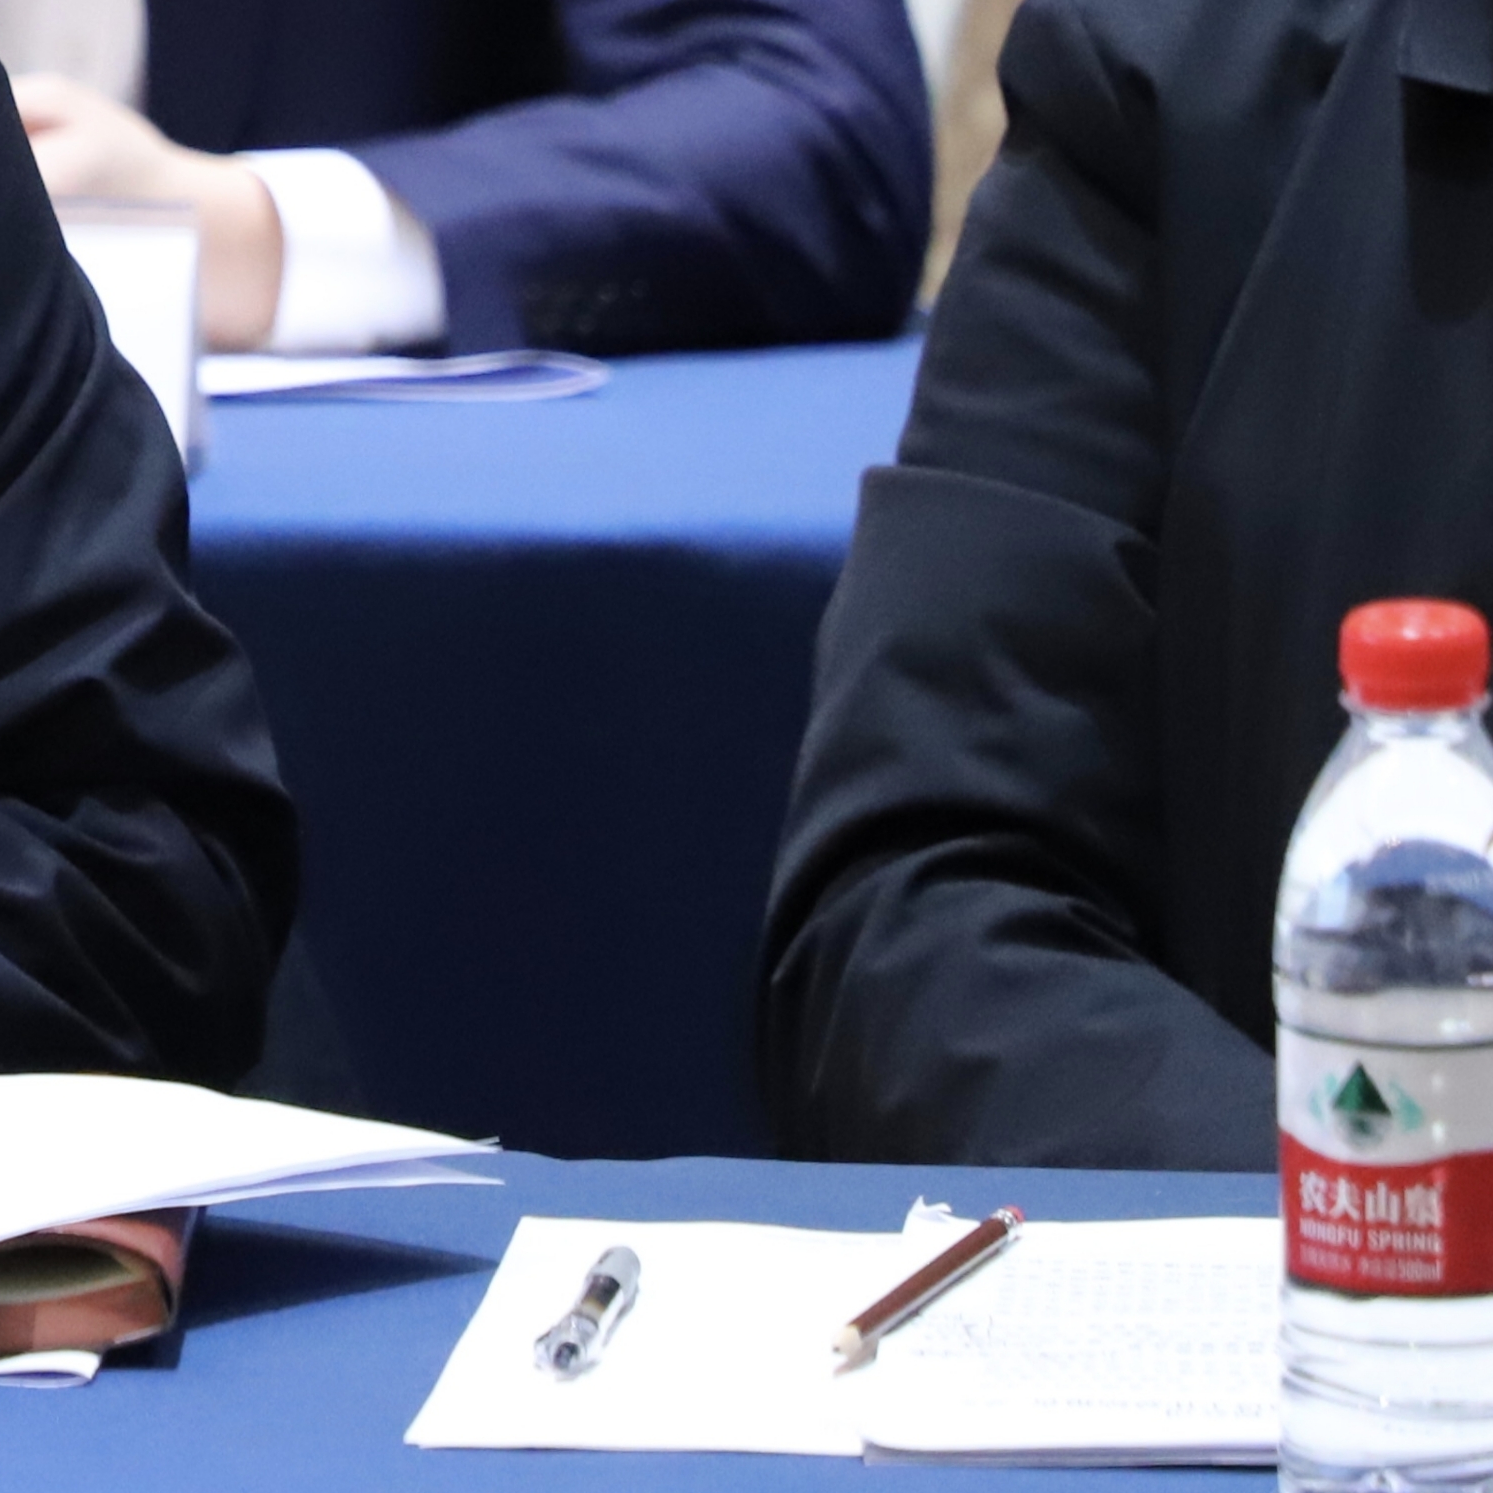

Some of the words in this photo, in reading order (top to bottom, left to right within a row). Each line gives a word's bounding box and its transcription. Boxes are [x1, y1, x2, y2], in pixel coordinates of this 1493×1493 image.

[1299, 1170, 1443, 1228] 农夫山泉
[1367, 1228, 1442, 1254] SPRING
